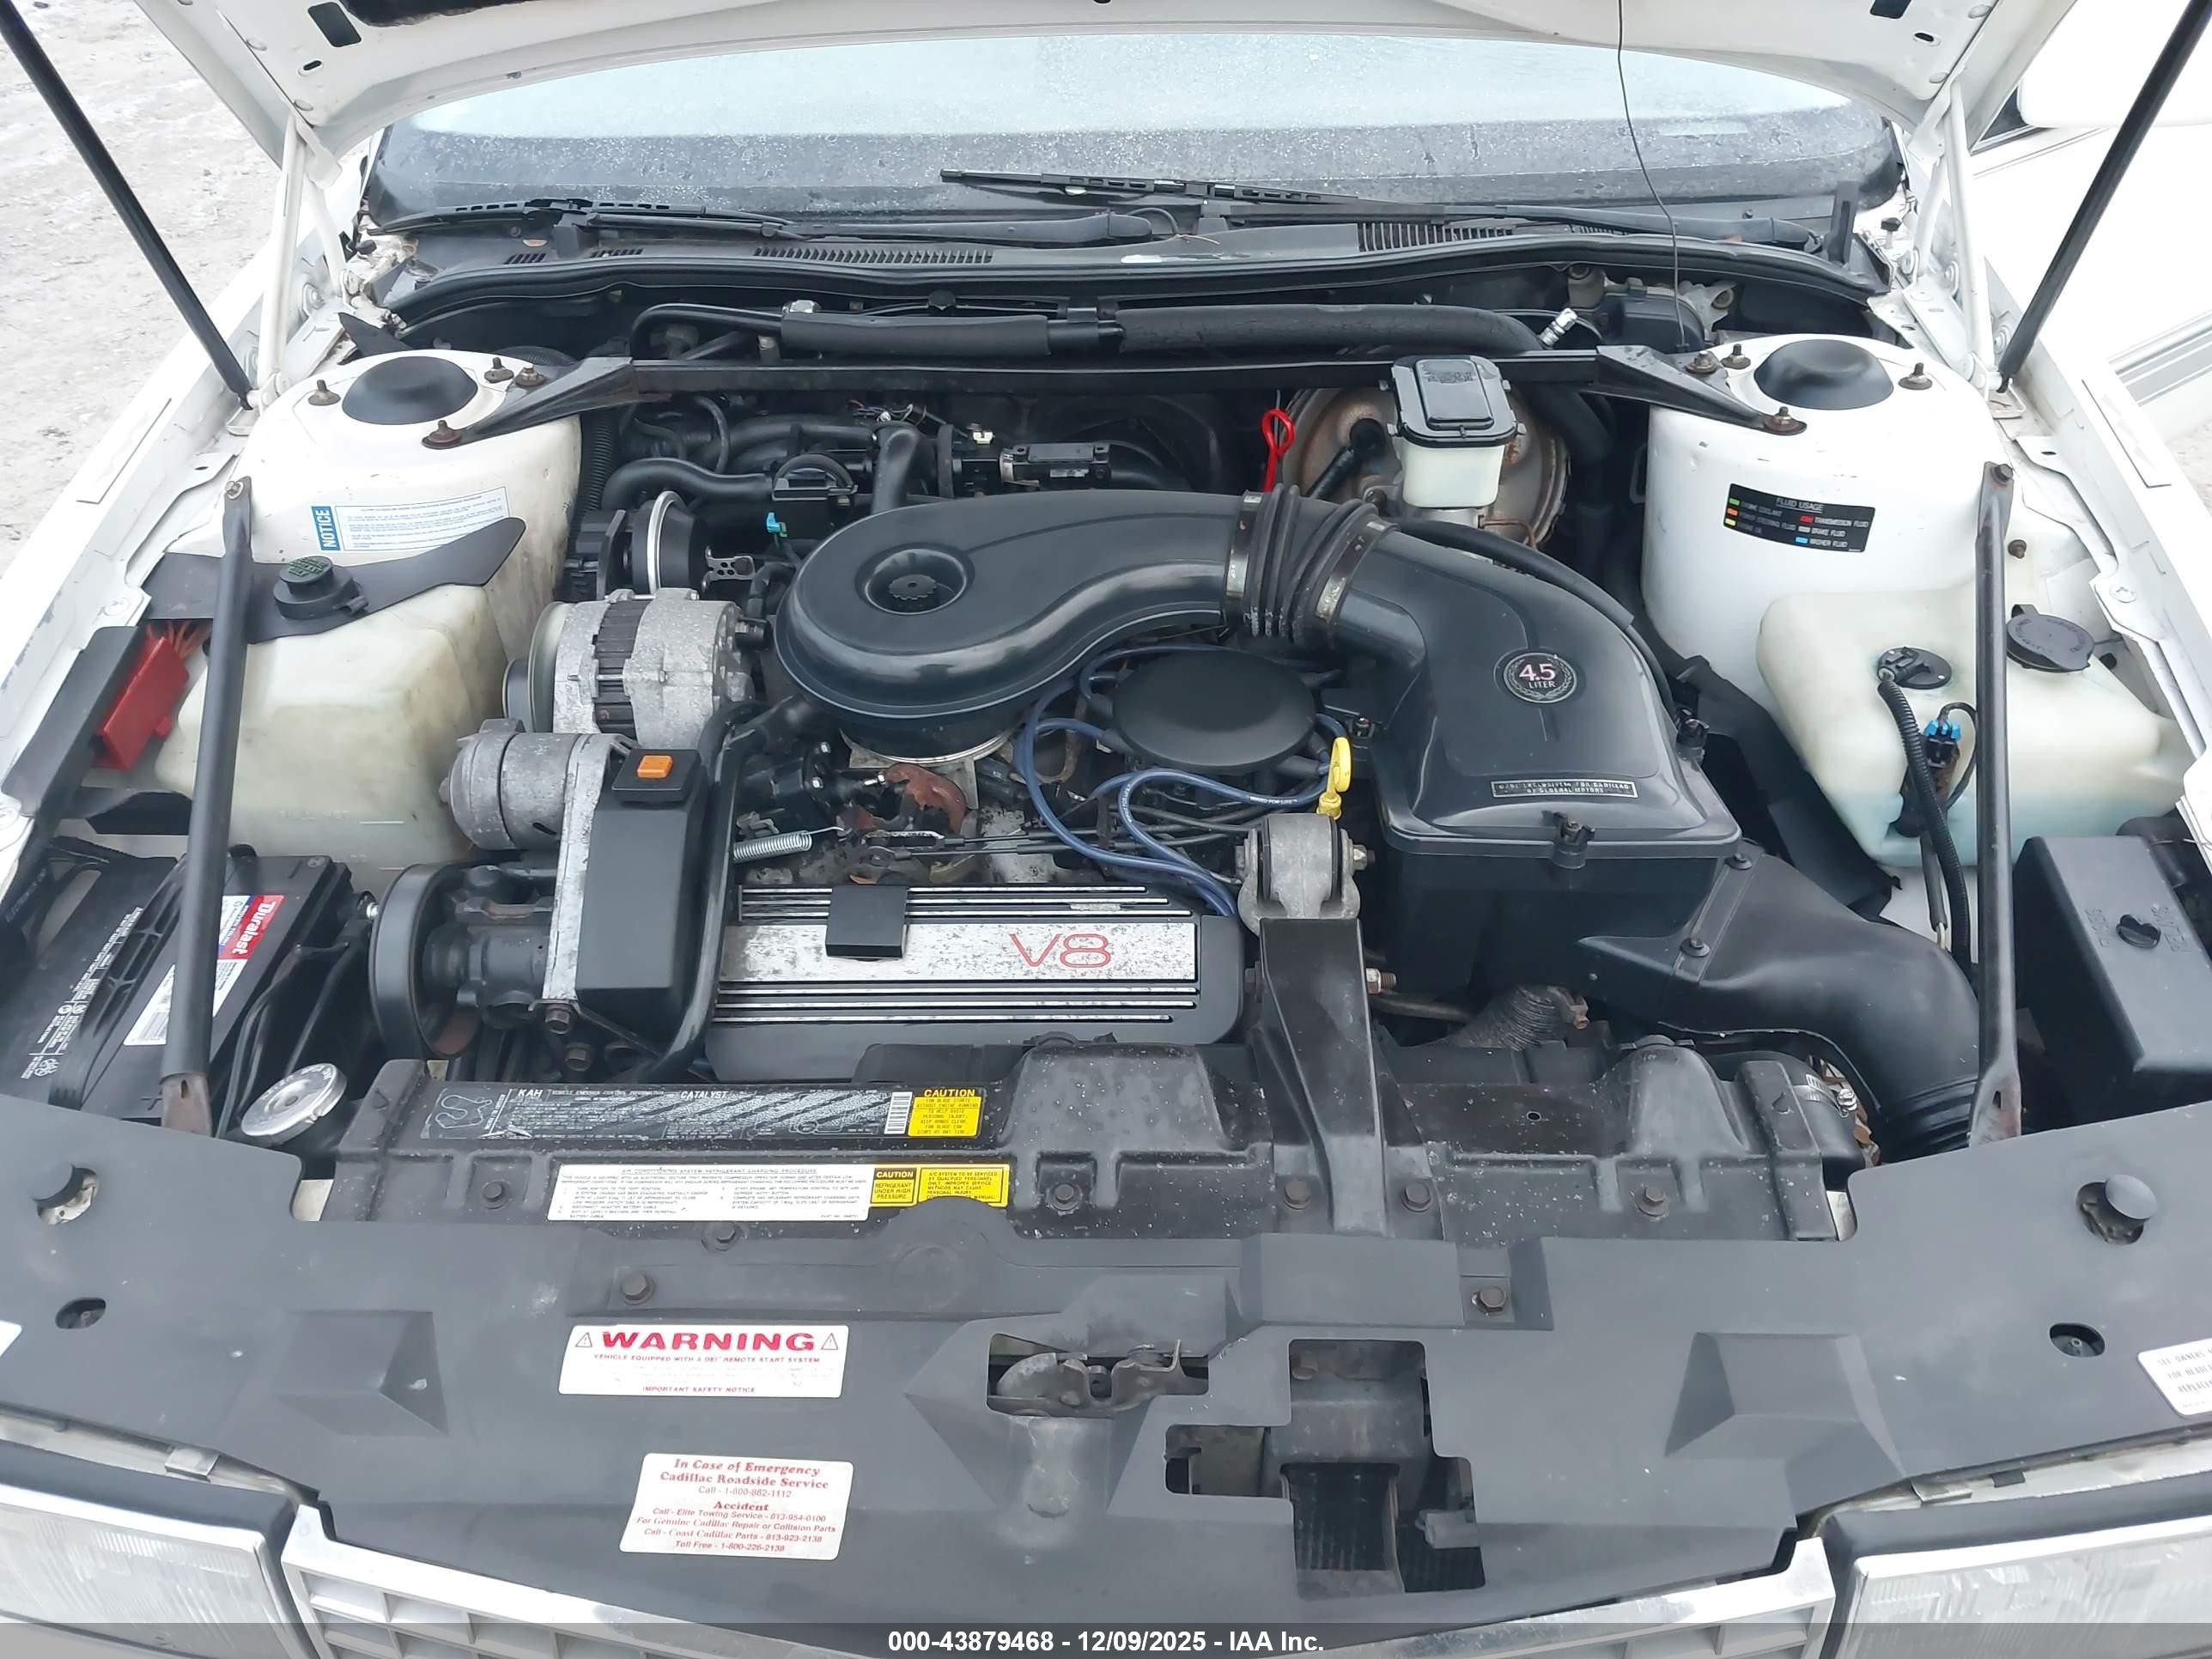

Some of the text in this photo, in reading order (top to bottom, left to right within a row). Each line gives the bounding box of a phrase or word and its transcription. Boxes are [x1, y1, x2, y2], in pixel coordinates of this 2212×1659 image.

[1777, 497, 1824, 511] FLUID USAGE
[318, 508, 337, 548] NOTICE
[1518, 663, 1556, 681] 4.5
[1528, 680, 1556, 689] LITER
[232, 900, 276, 955] Duralast
[1009, 933, 1111, 968] V8
[518, 1089, 544, 1098] KAH
[680, 1091, 728, 1100] CATALYST
[924, 1089, 975, 1097] CAUTION
[603, 1332, 815, 1351] WARNING
[674, 1458, 820, 1478] In Case of Emergency
[659, 1471, 829, 1489] Cadillac Roadside Service
[698, 1486, 716, 1494] Call
[714, 1501, 769, 1510] Accident
[698, 1510, 728, 1519] Towing
[653, 1517, 691, 1526] Genuine
[693, 1519, 729, 1528] Cadillac
[732, 1521, 760, 1530] Repair
[774, 1522, 811, 1531] Collision
[668, 1528, 694, 1537] Coast
[696, 1530, 732, 1539] Cadillac
